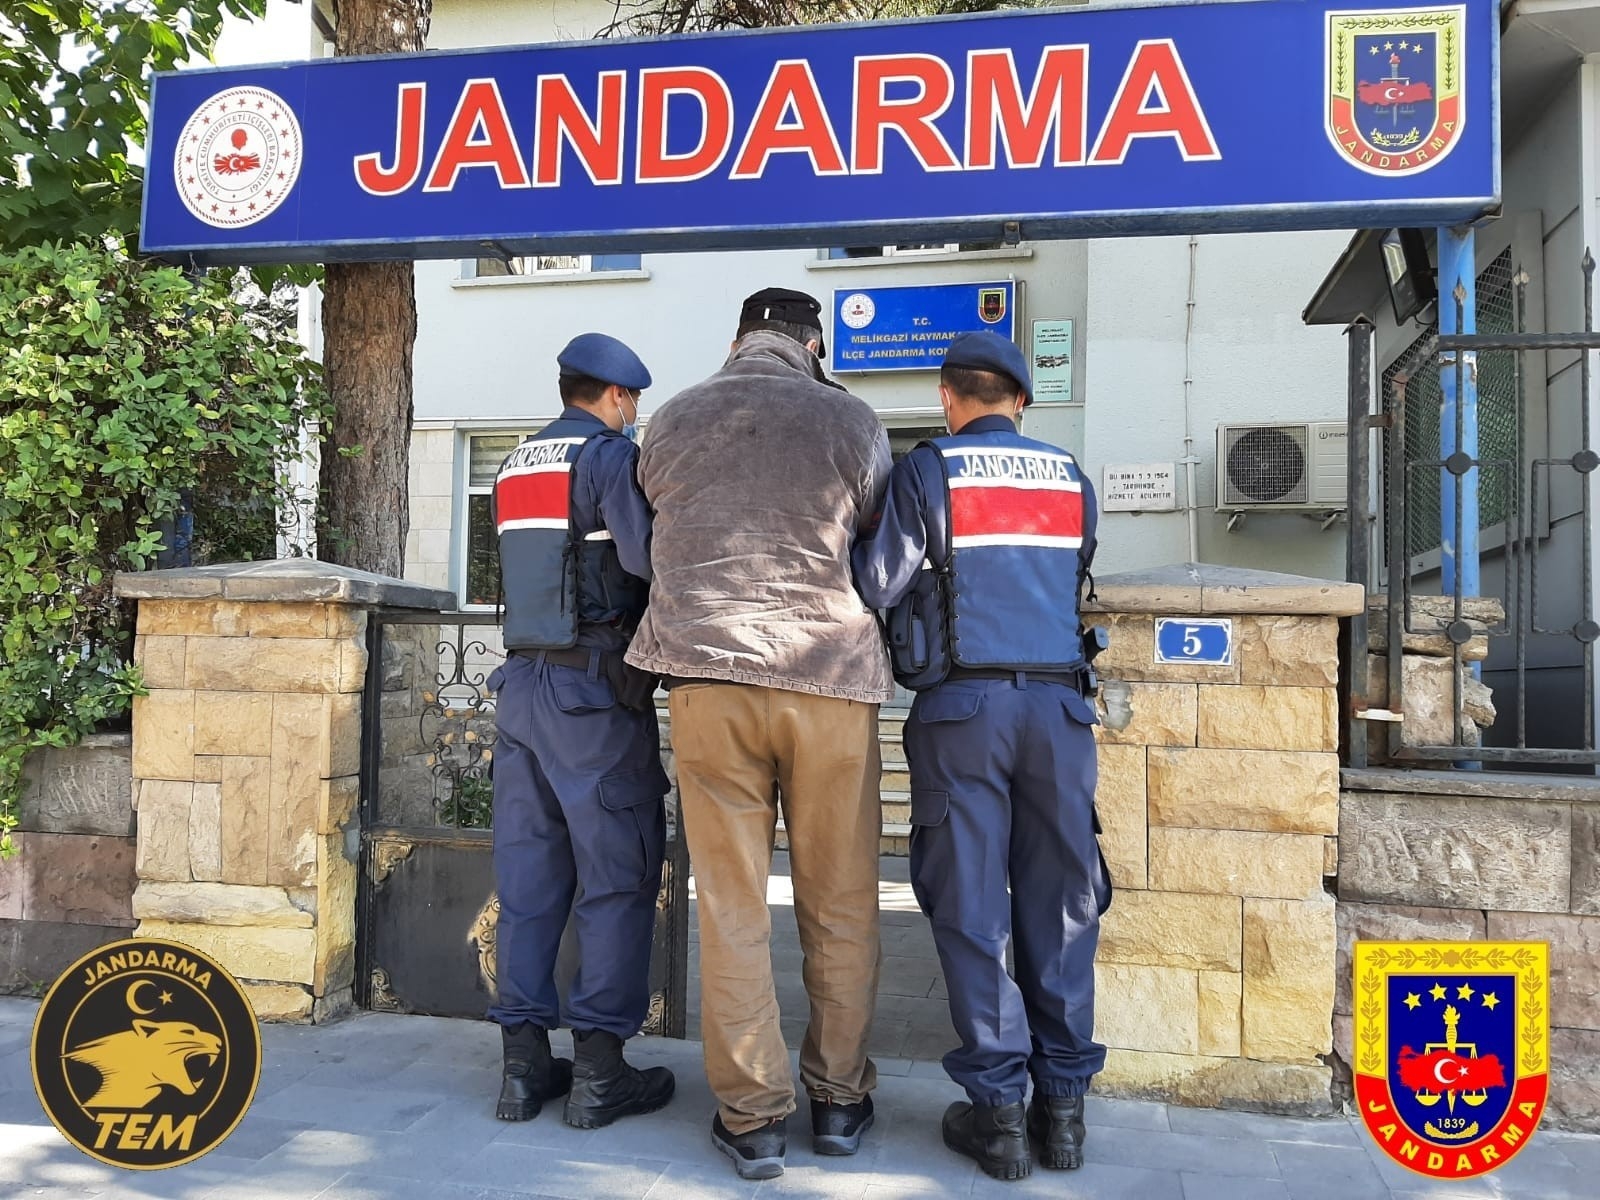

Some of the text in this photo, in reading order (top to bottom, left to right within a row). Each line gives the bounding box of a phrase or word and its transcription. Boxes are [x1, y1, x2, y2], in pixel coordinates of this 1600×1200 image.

[353, 38, 1222, 196] JANDARMA
[1336, 120, 1455, 167] JANDARMA
[912, 317, 931, 326] T.C.
[851, 333, 908, 344] MELİKGAZİ
[842, 349, 865, 360] İLÇE
[868, 349, 925, 359] JANDARMA
[959, 455, 1071, 481] JANDARMA
[1183, 627, 1202, 655] 5
